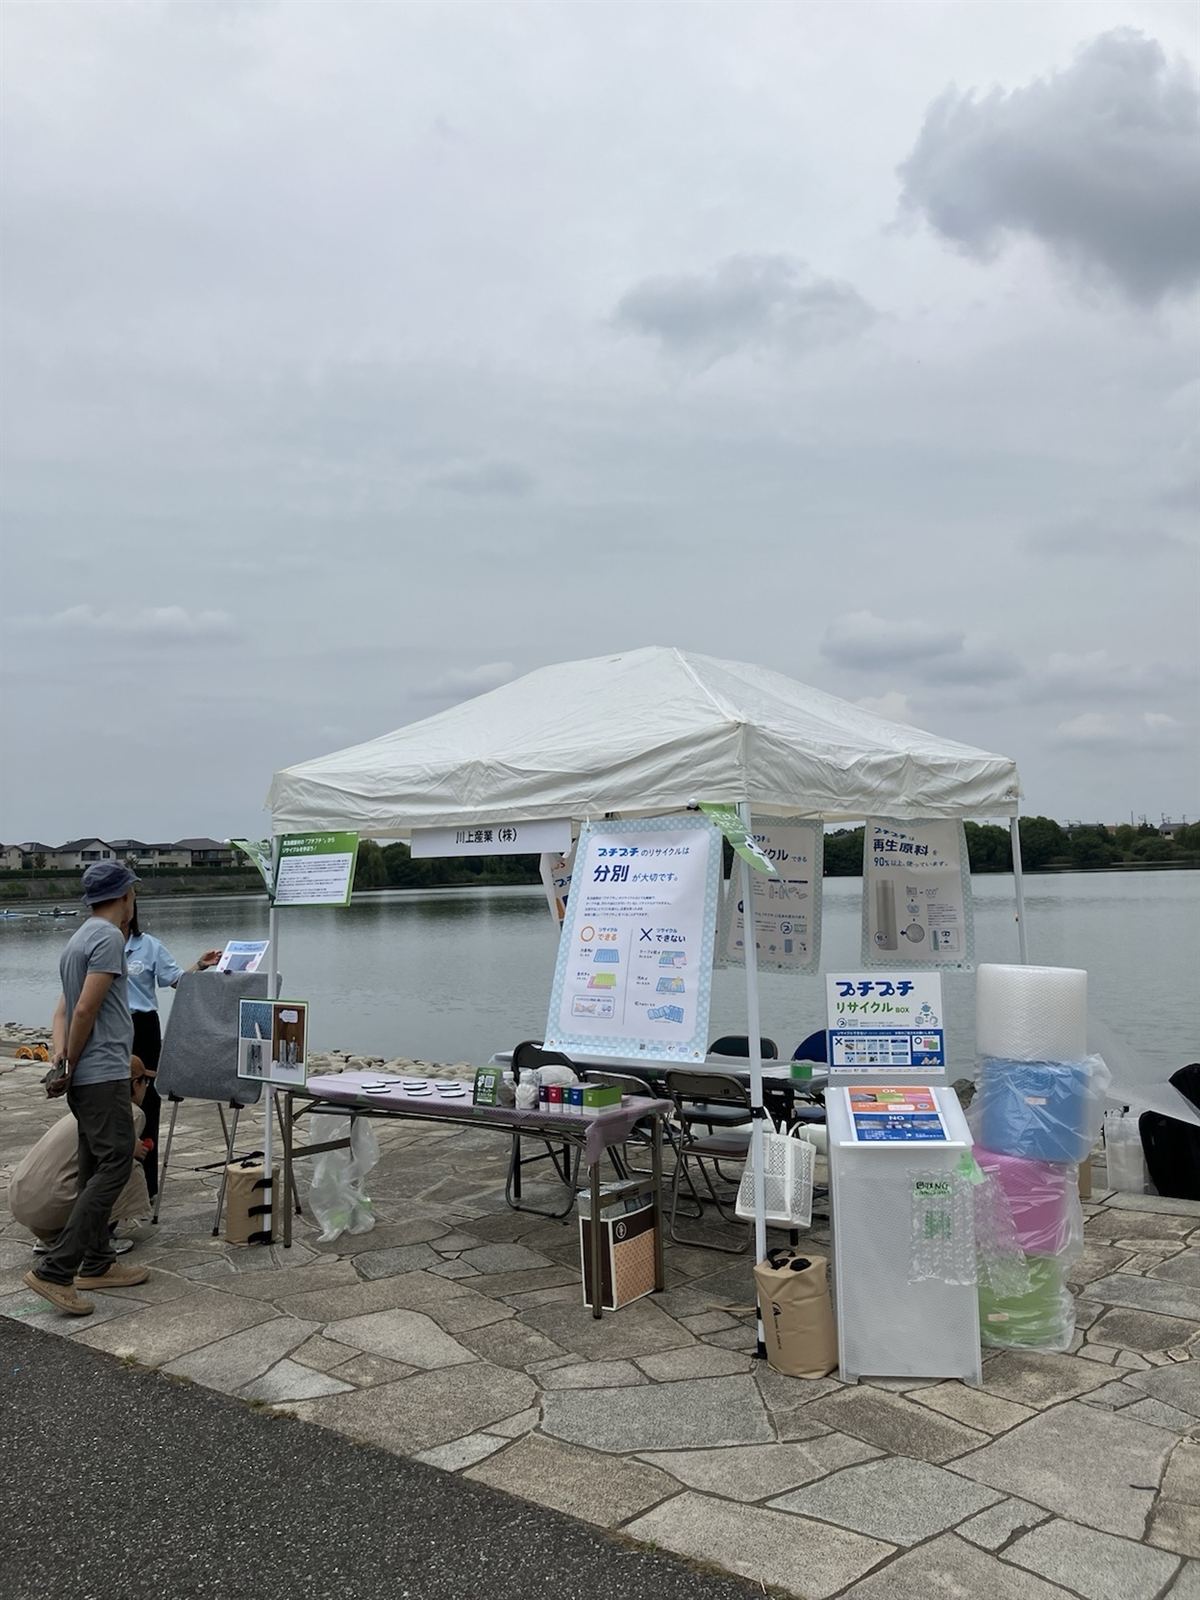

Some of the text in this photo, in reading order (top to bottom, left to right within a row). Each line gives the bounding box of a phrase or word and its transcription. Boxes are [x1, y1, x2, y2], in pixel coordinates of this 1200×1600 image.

[455, 827, 518, 845] 川上産業（株）
[598, 933, 617, 941] できる
[655, 934, 686, 943] できない
[835, 981, 915, 997] プチプチ
